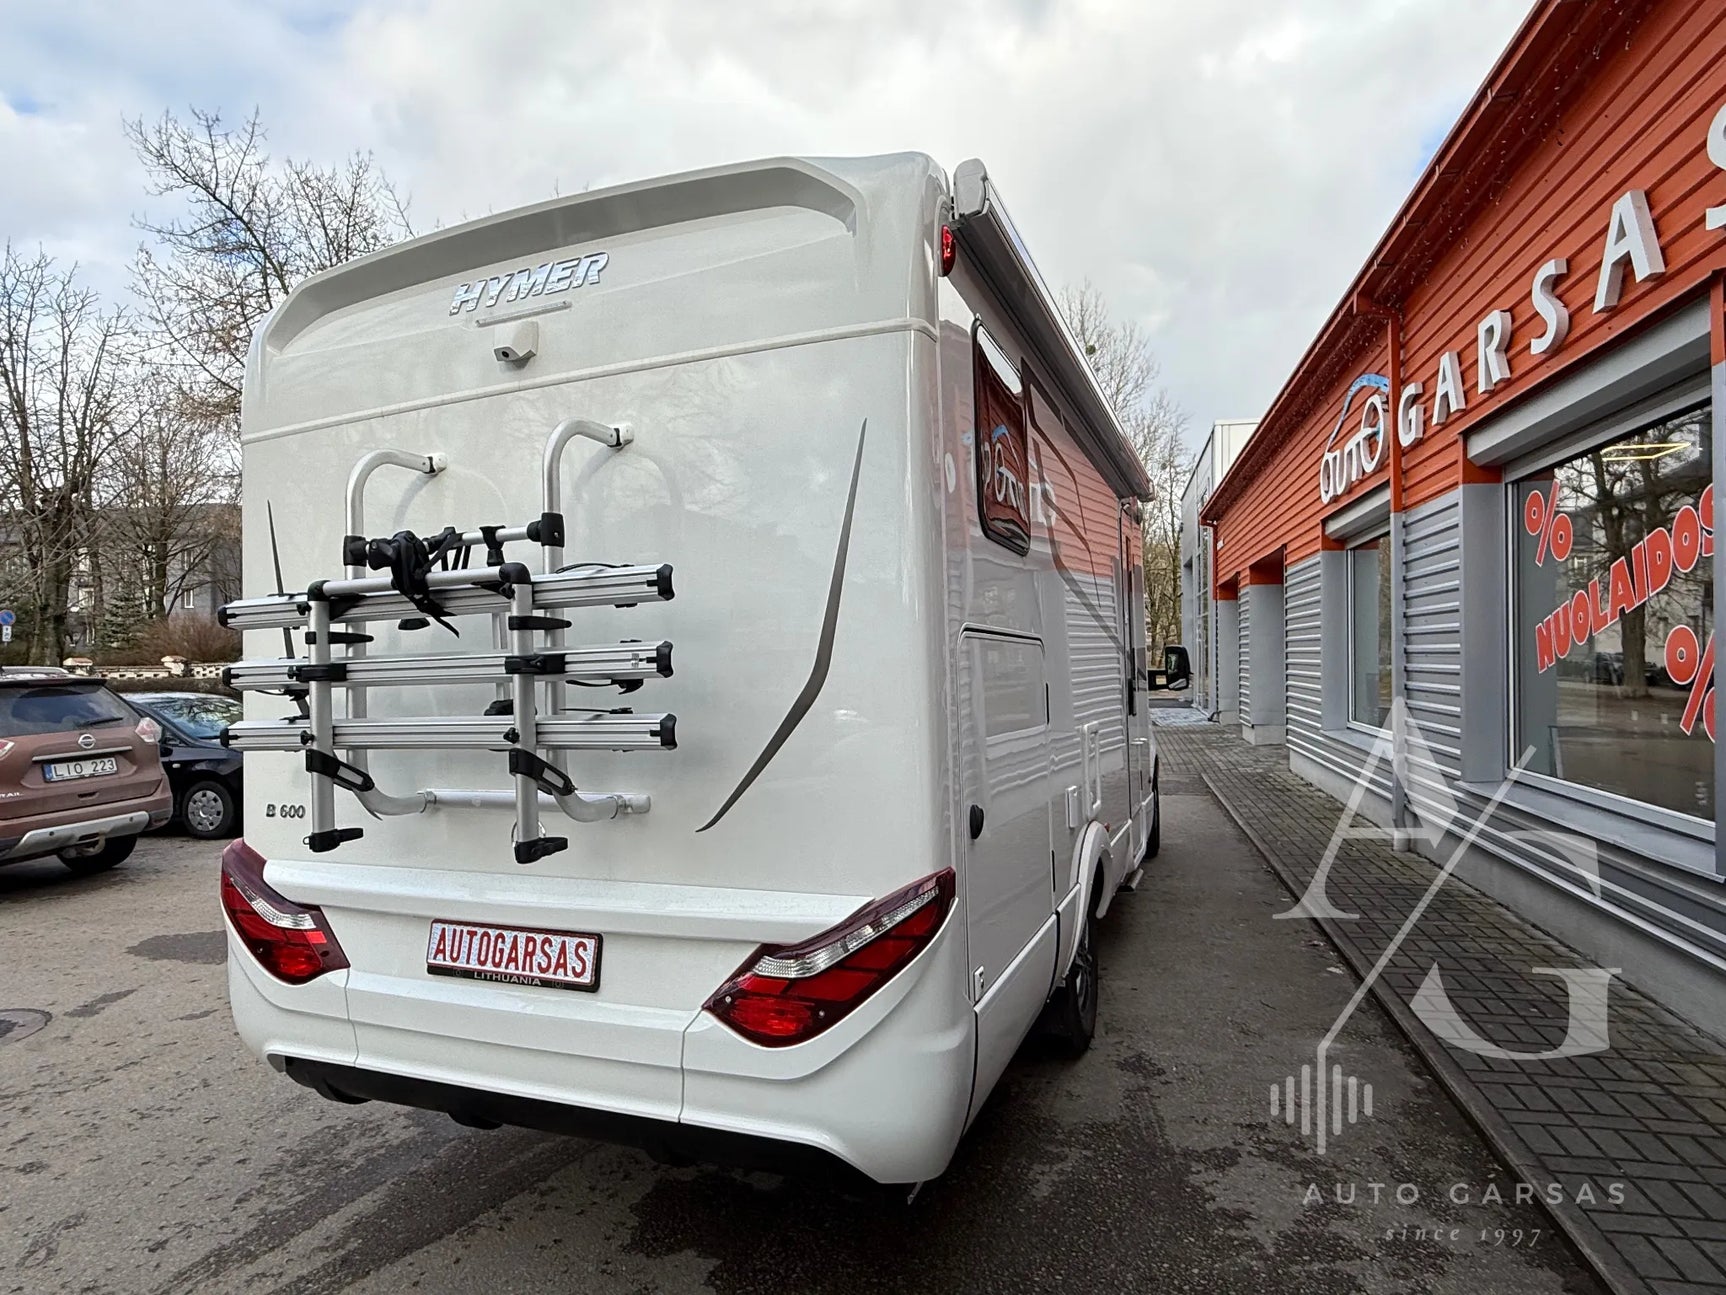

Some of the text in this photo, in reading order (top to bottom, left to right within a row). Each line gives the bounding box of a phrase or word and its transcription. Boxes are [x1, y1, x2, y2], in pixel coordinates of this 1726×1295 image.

[449, 251, 610, 316] HYMER
[53, 760, 115, 777] LIO 223
[265, 803, 306, 819] B 600
[433, 927, 588, 978] AUTOGARSAS
[474, 971, 542, 986] LITHUANIA
